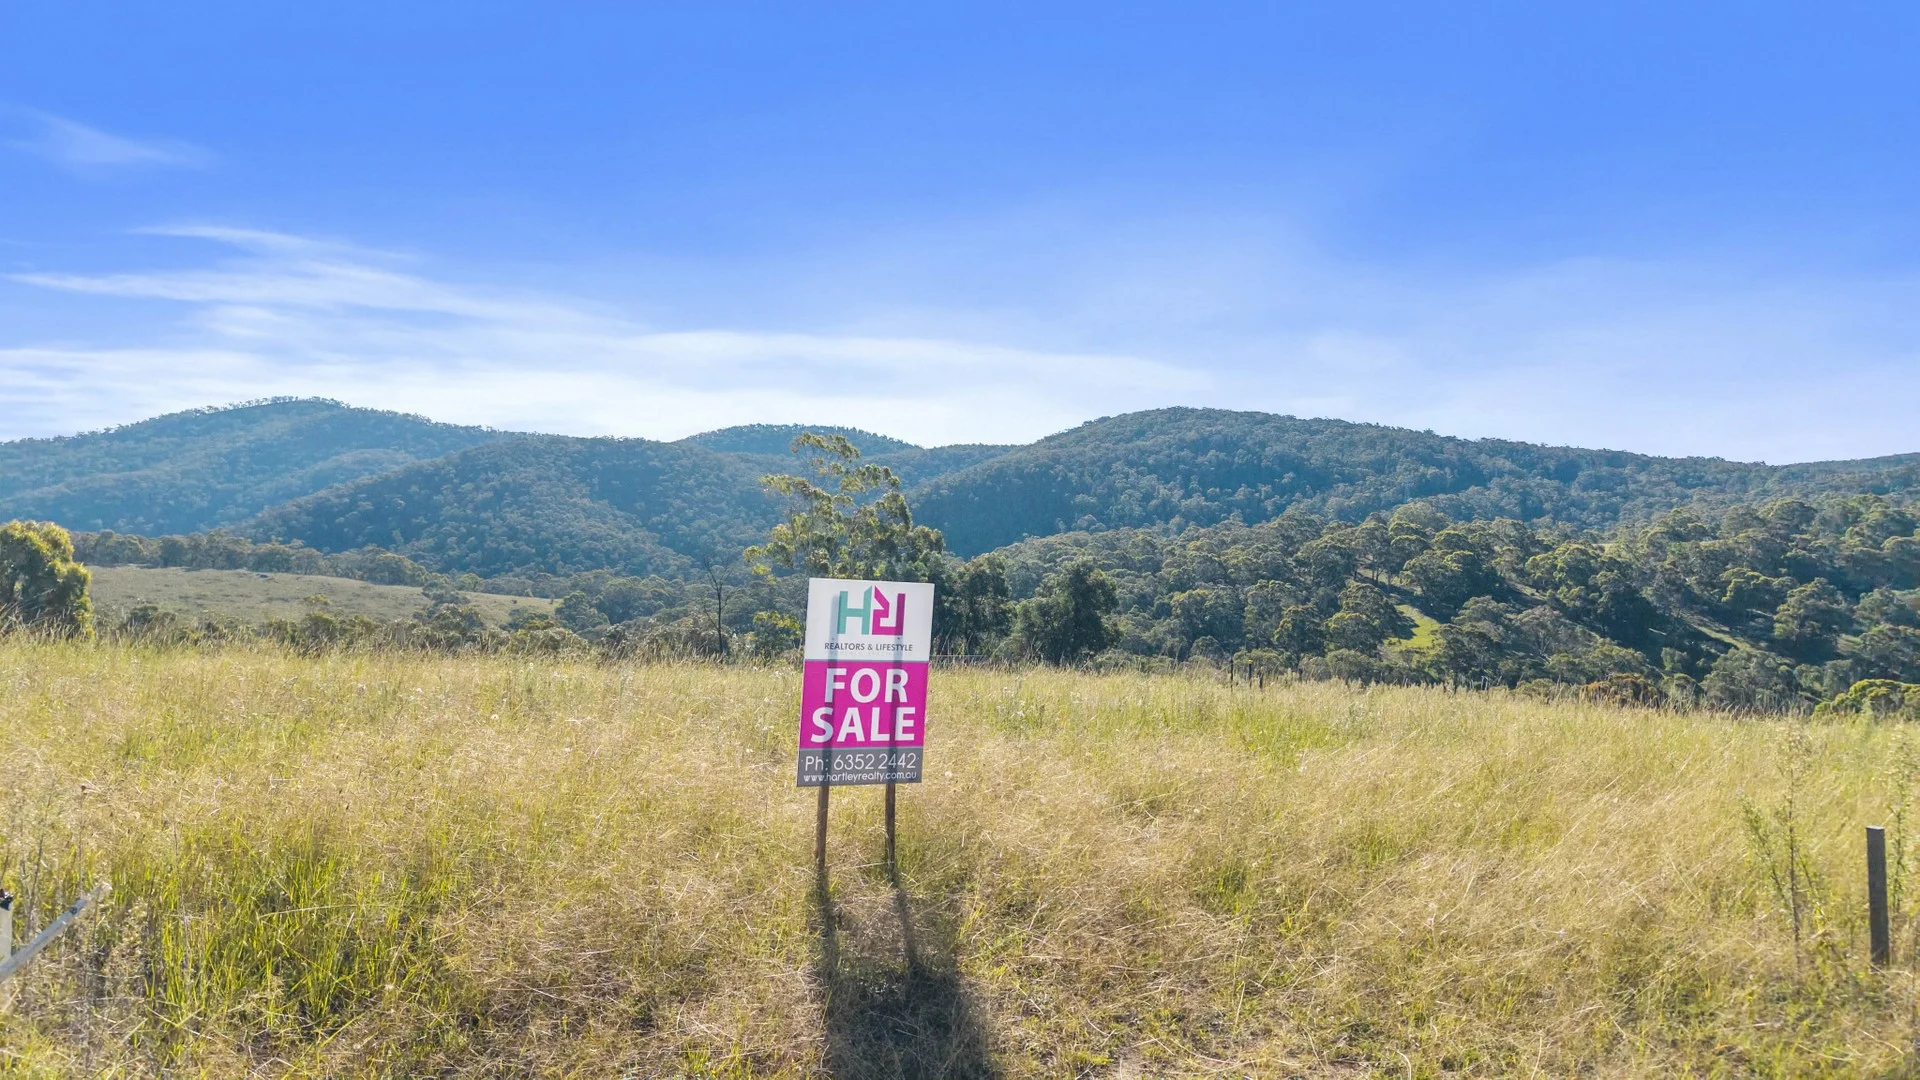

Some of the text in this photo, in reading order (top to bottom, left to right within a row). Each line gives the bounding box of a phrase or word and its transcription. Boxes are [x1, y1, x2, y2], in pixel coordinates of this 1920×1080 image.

[824, 642, 913, 652] REALTORS & LIFESTYLE
[824, 667, 909, 704] FOR
[810, 706, 916, 743] SALE
[805, 752, 917, 771] Ph: 6352 2442
[803, 771, 917, 783] www.hartleyrealty.com.au
